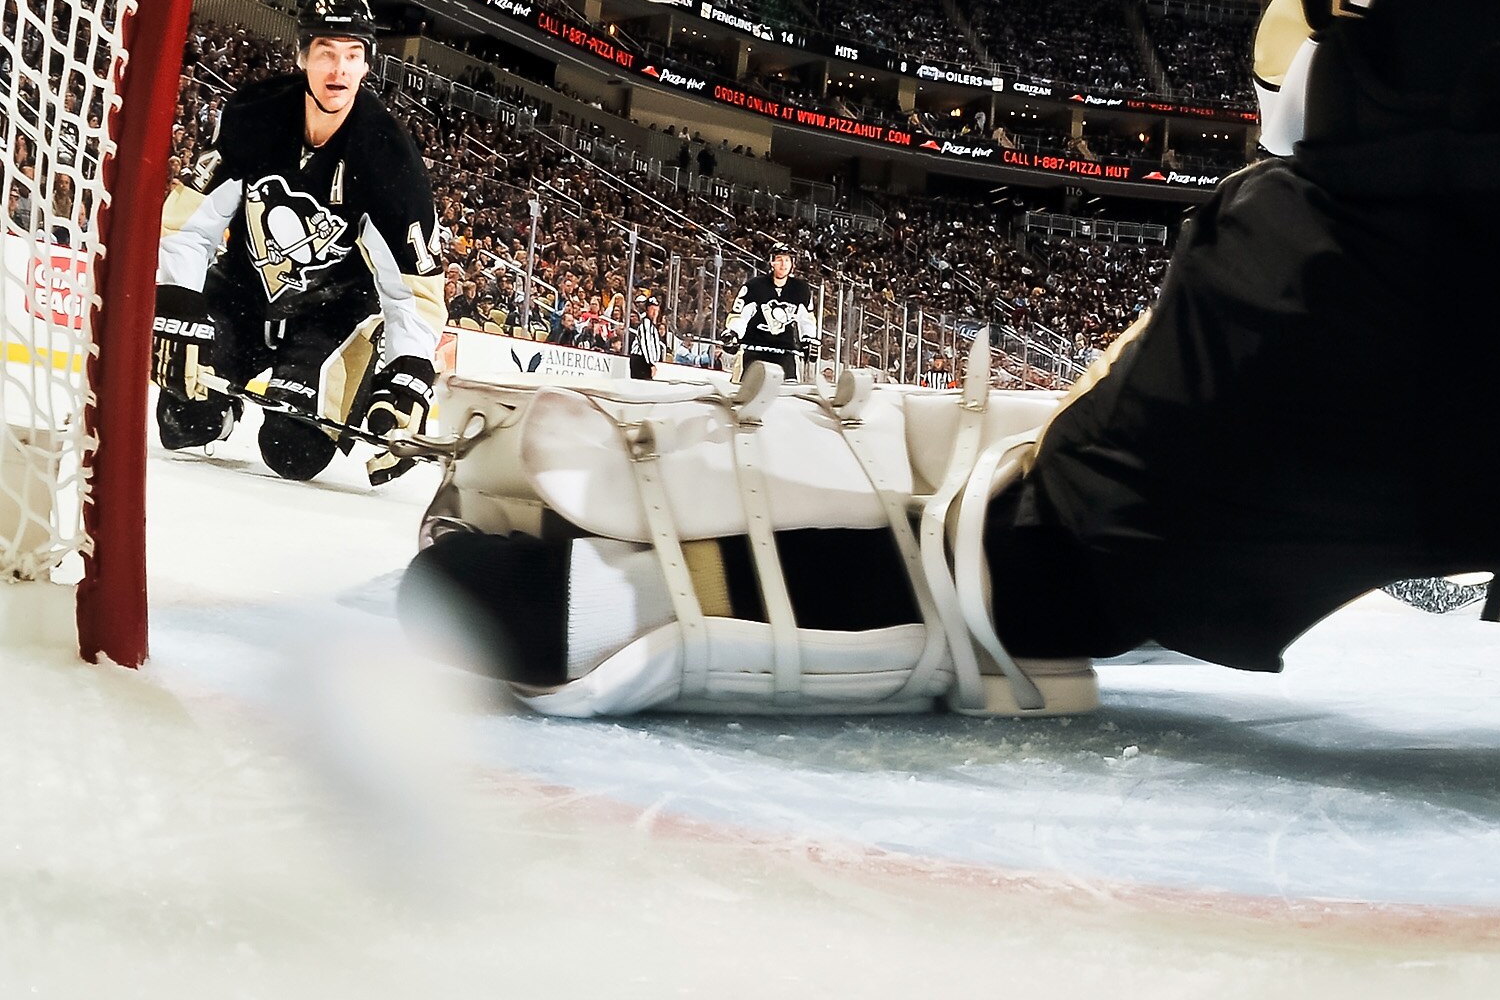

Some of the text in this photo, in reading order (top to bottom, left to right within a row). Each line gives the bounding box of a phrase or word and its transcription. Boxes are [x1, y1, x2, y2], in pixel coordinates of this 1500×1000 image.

[512, 1, 532, 18] Hut
[537, 12, 559, 36] CALL
[615, 47, 634, 68] HUT
[712, 8, 753, 32] PENGUINS
[781, 31, 794, 44] 14
[835, 45, 858, 60] HITS
[946, 72, 983, 87] OILERS
[1013, 82, 1052, 94] CRUZAN
[1085, 95, 1107, 106] Pizza
[1106, 98, 1123, 106] Hut
[407, 72, 424, 92] 113
[501, 110, 516, 126] 113
[659, 68, 687, 87] Pizza
[686, 74, 706, 91] Hut
[714, 85, 745, 106] ORDER
[746, 95, 779, 118] ONLINE
[781, 108, 793, 121] AT
[941, 141, 972, 156] Pizza
[971, 146, 994, 158] Hut
[1003, 150, 1030, 167] CALL
[1033, 156, 1102, 177] 1-887-PIZZA
[1105, 165, 1131, 179] HUT
[1166, 171, 1197, 185] Pizza
[1196, 173, 1220, 186] Hut
[578, 138, 593, 152] 114
[635, 158, 648, 173] 114
[329, 158, 347, 205] A
[714, 183, 729, 199] 115
[1066, 185, 1084, 197] 116
[546, 350, 611, 373] AMERICAN
